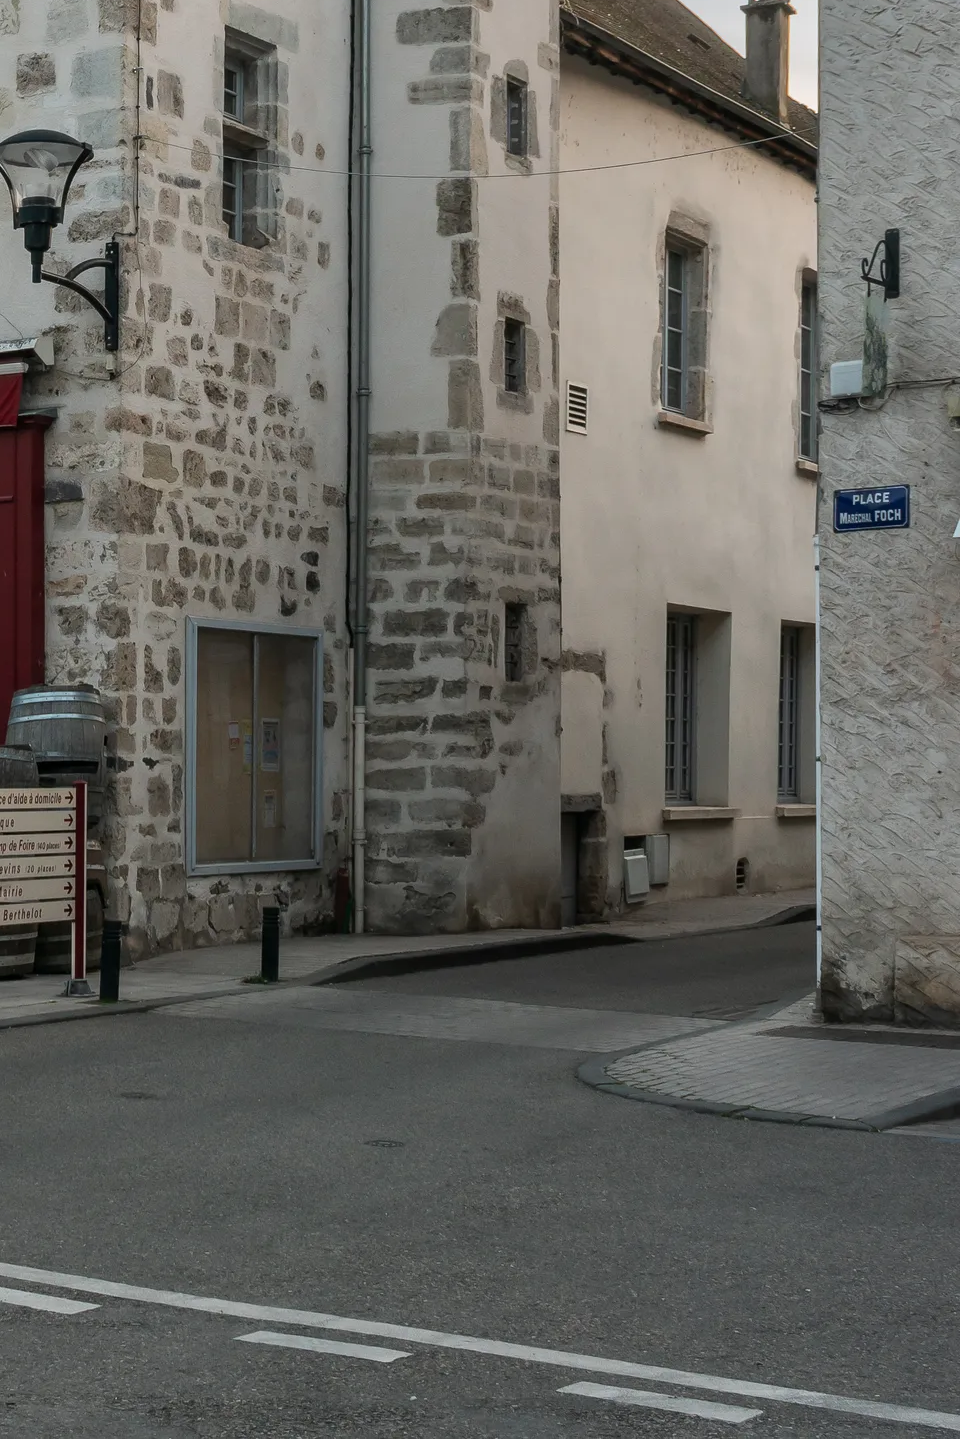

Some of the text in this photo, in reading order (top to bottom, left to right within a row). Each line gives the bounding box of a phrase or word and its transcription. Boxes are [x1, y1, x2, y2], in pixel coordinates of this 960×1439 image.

[852, 492, 890, 505] PLACE
[840, 508, 901, 524] MARÉCHAL FOCH
[8, 793, 28, 805] d'aide
[29, 793, 33, 804] à
[35, 792, 62, 804] domicile
[8, 840, 17, 851] de
[19, 839, 35, 851] Foire
[3, 907, 42, 921] Berthelot
